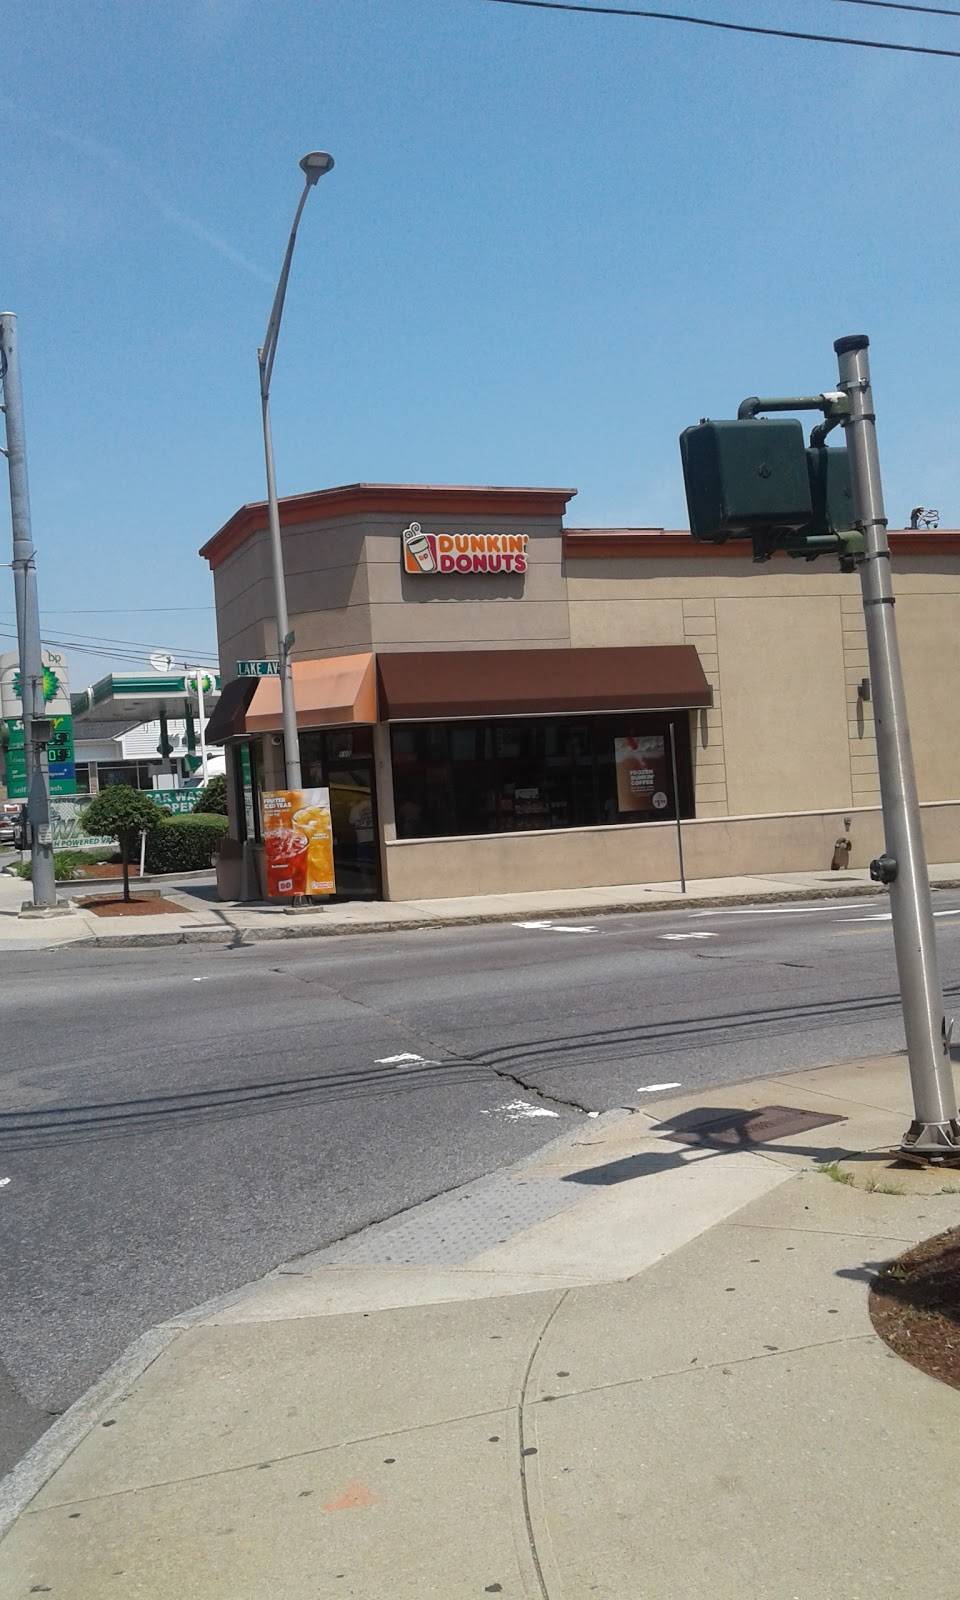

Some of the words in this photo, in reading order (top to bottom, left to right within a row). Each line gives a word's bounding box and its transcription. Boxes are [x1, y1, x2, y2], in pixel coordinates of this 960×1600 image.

[438, 534, 529, 553] DUNKIN'
[439, 554, 527, 572] DONUTS
[47, 649, 62, 663] bp
[238, 662, 262, 675] LAKE
[175, 790, 203, 803] WAS
[61, 837, 100, 846] POWERED
